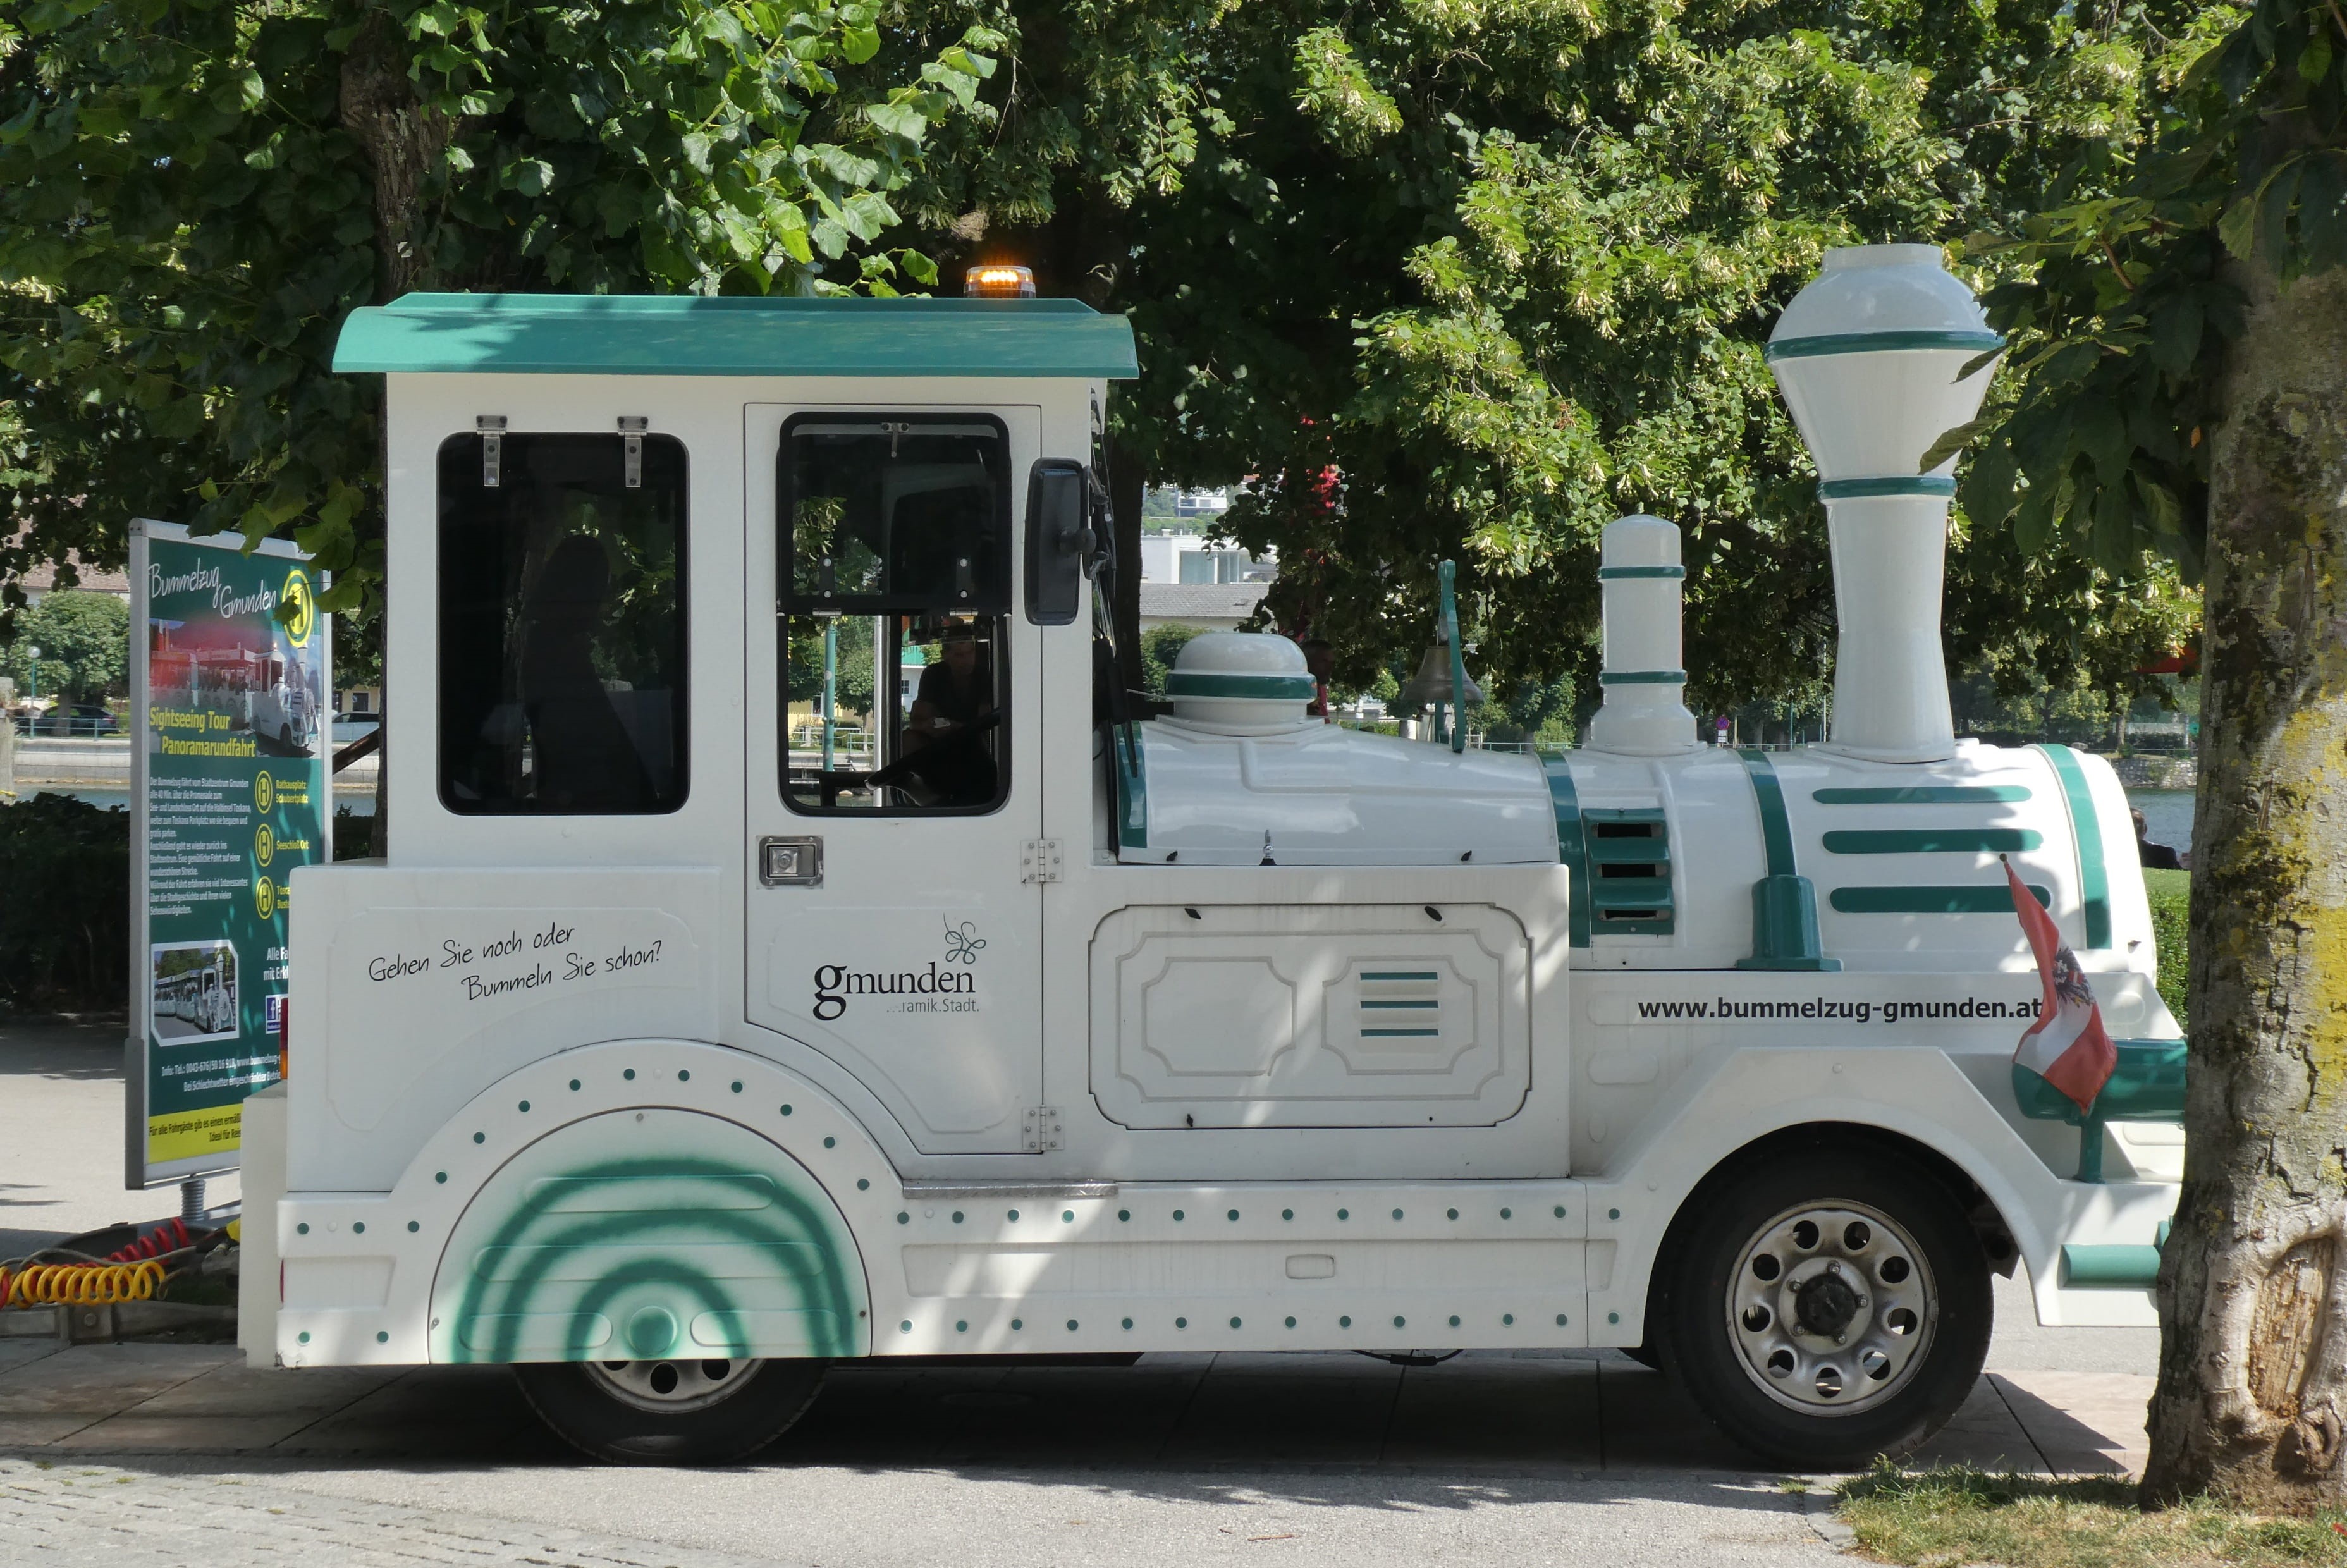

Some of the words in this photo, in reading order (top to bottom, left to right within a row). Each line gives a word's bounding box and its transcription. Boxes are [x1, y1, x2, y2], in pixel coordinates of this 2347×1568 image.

[149, 558, 221, 609] Bummelzug
[220, 579, 276, 619] Gmunden
[149, 707, 206, 733] Sightseeing
[208, 711, 230, 730] Tour
[161, 736, 256, 758] Panoramarundfahrt
[276, 780, 306, 790] Rathausplatz
[276, 793, 309, 804] Schubertplatz
[267, 948, 279, 960] Alle
[369, 954, 429, 981] Gehen
[440, 940, 474, 967] Sie
[482, 931, 522, 958] noch
[533, 922, 575, 948] oder
[263, 966, 274, 980] mit
[461, 963, 552, 1001] Bummeln
[562, 953, 596, 981] Sie
[605, 940, 662, 972] schon?
[812, 961, 976, 1022] gmunden
[1638, 997, 2042, 1024] www.bummelzug-gmunden.at
[149, 1126, 157, 1136] Für
[158, 1124, 168, 1135] alle
[168, 1122, 193, 1134] Fahrgäste
[209, 1130, 222, 1142] Ideal
